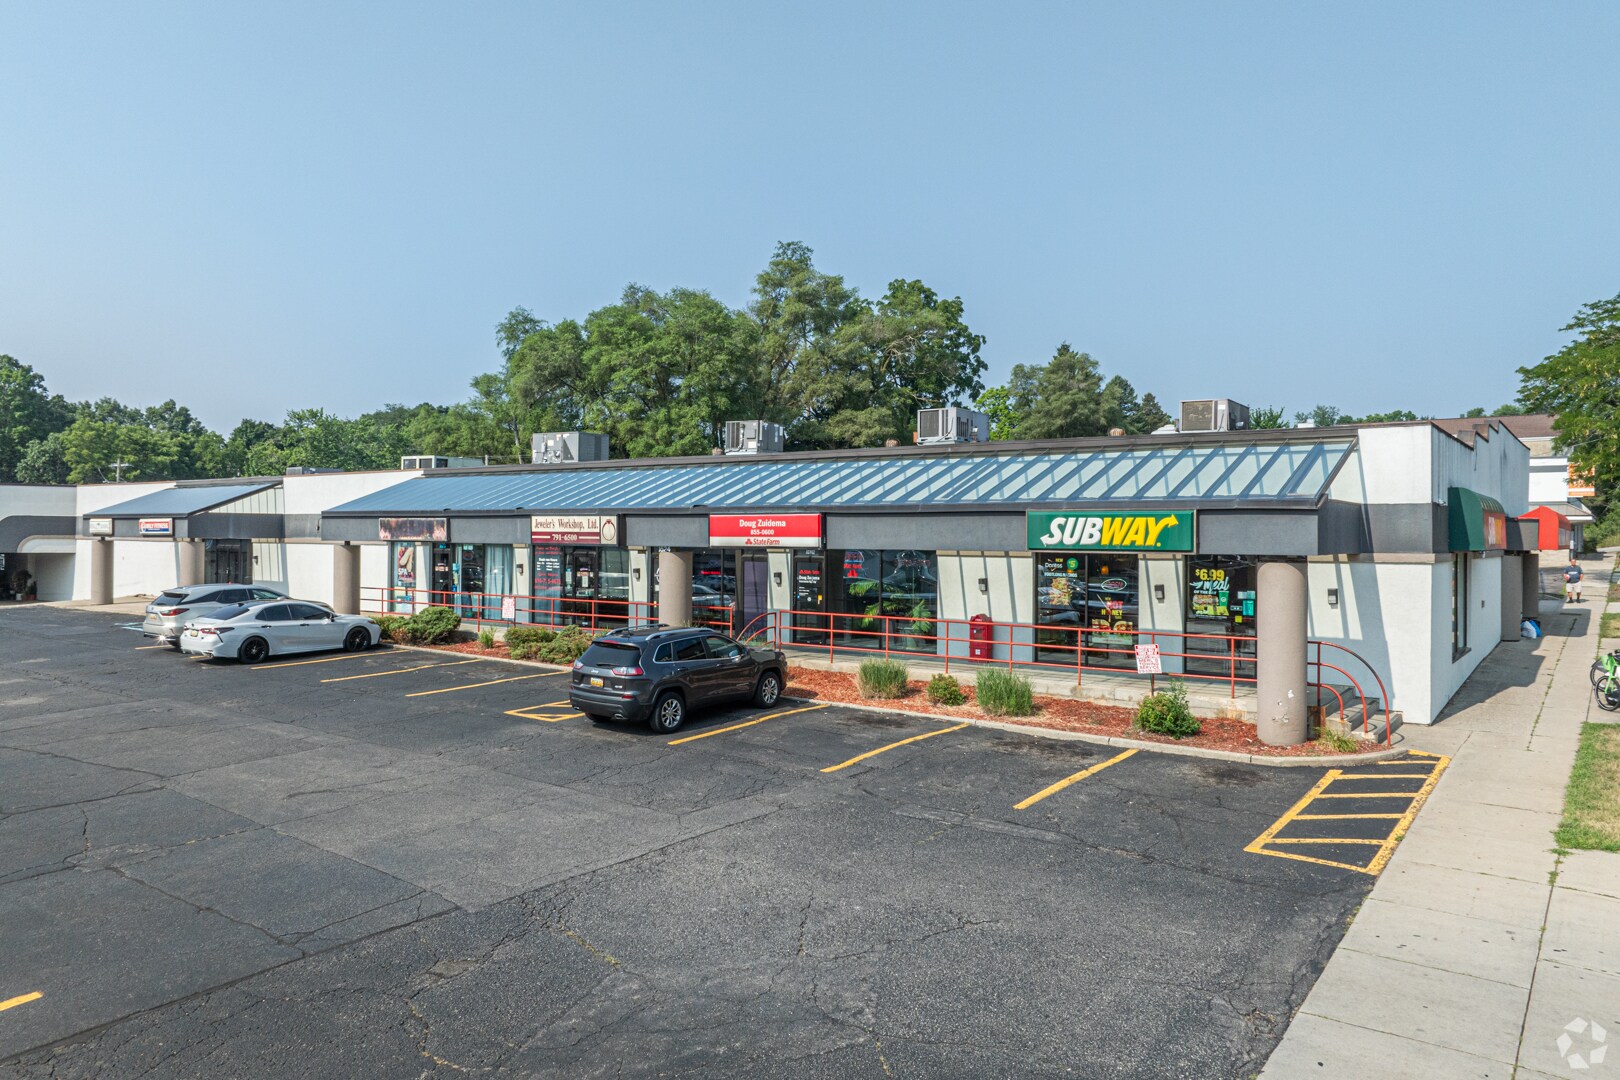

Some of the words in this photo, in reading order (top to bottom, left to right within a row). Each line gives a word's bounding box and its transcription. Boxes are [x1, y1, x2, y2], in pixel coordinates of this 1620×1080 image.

[534, 518, 555, 529] Jeweler's
[557, 518, 585, 531] Workshop,
[587, 518, 598, 529] Ltd.
[739, 519, 756, 529] Doug
[757, 519, 786, 527] Zuidema
[1040, 514, 1179, 547] SUBWAY
[551, 533, 578, 541] 791-6500
[399, 567, 408, 575] SPA
[1195, 568, 1225, 581] $6.99
[1203, 576, 1230, 591] meal
